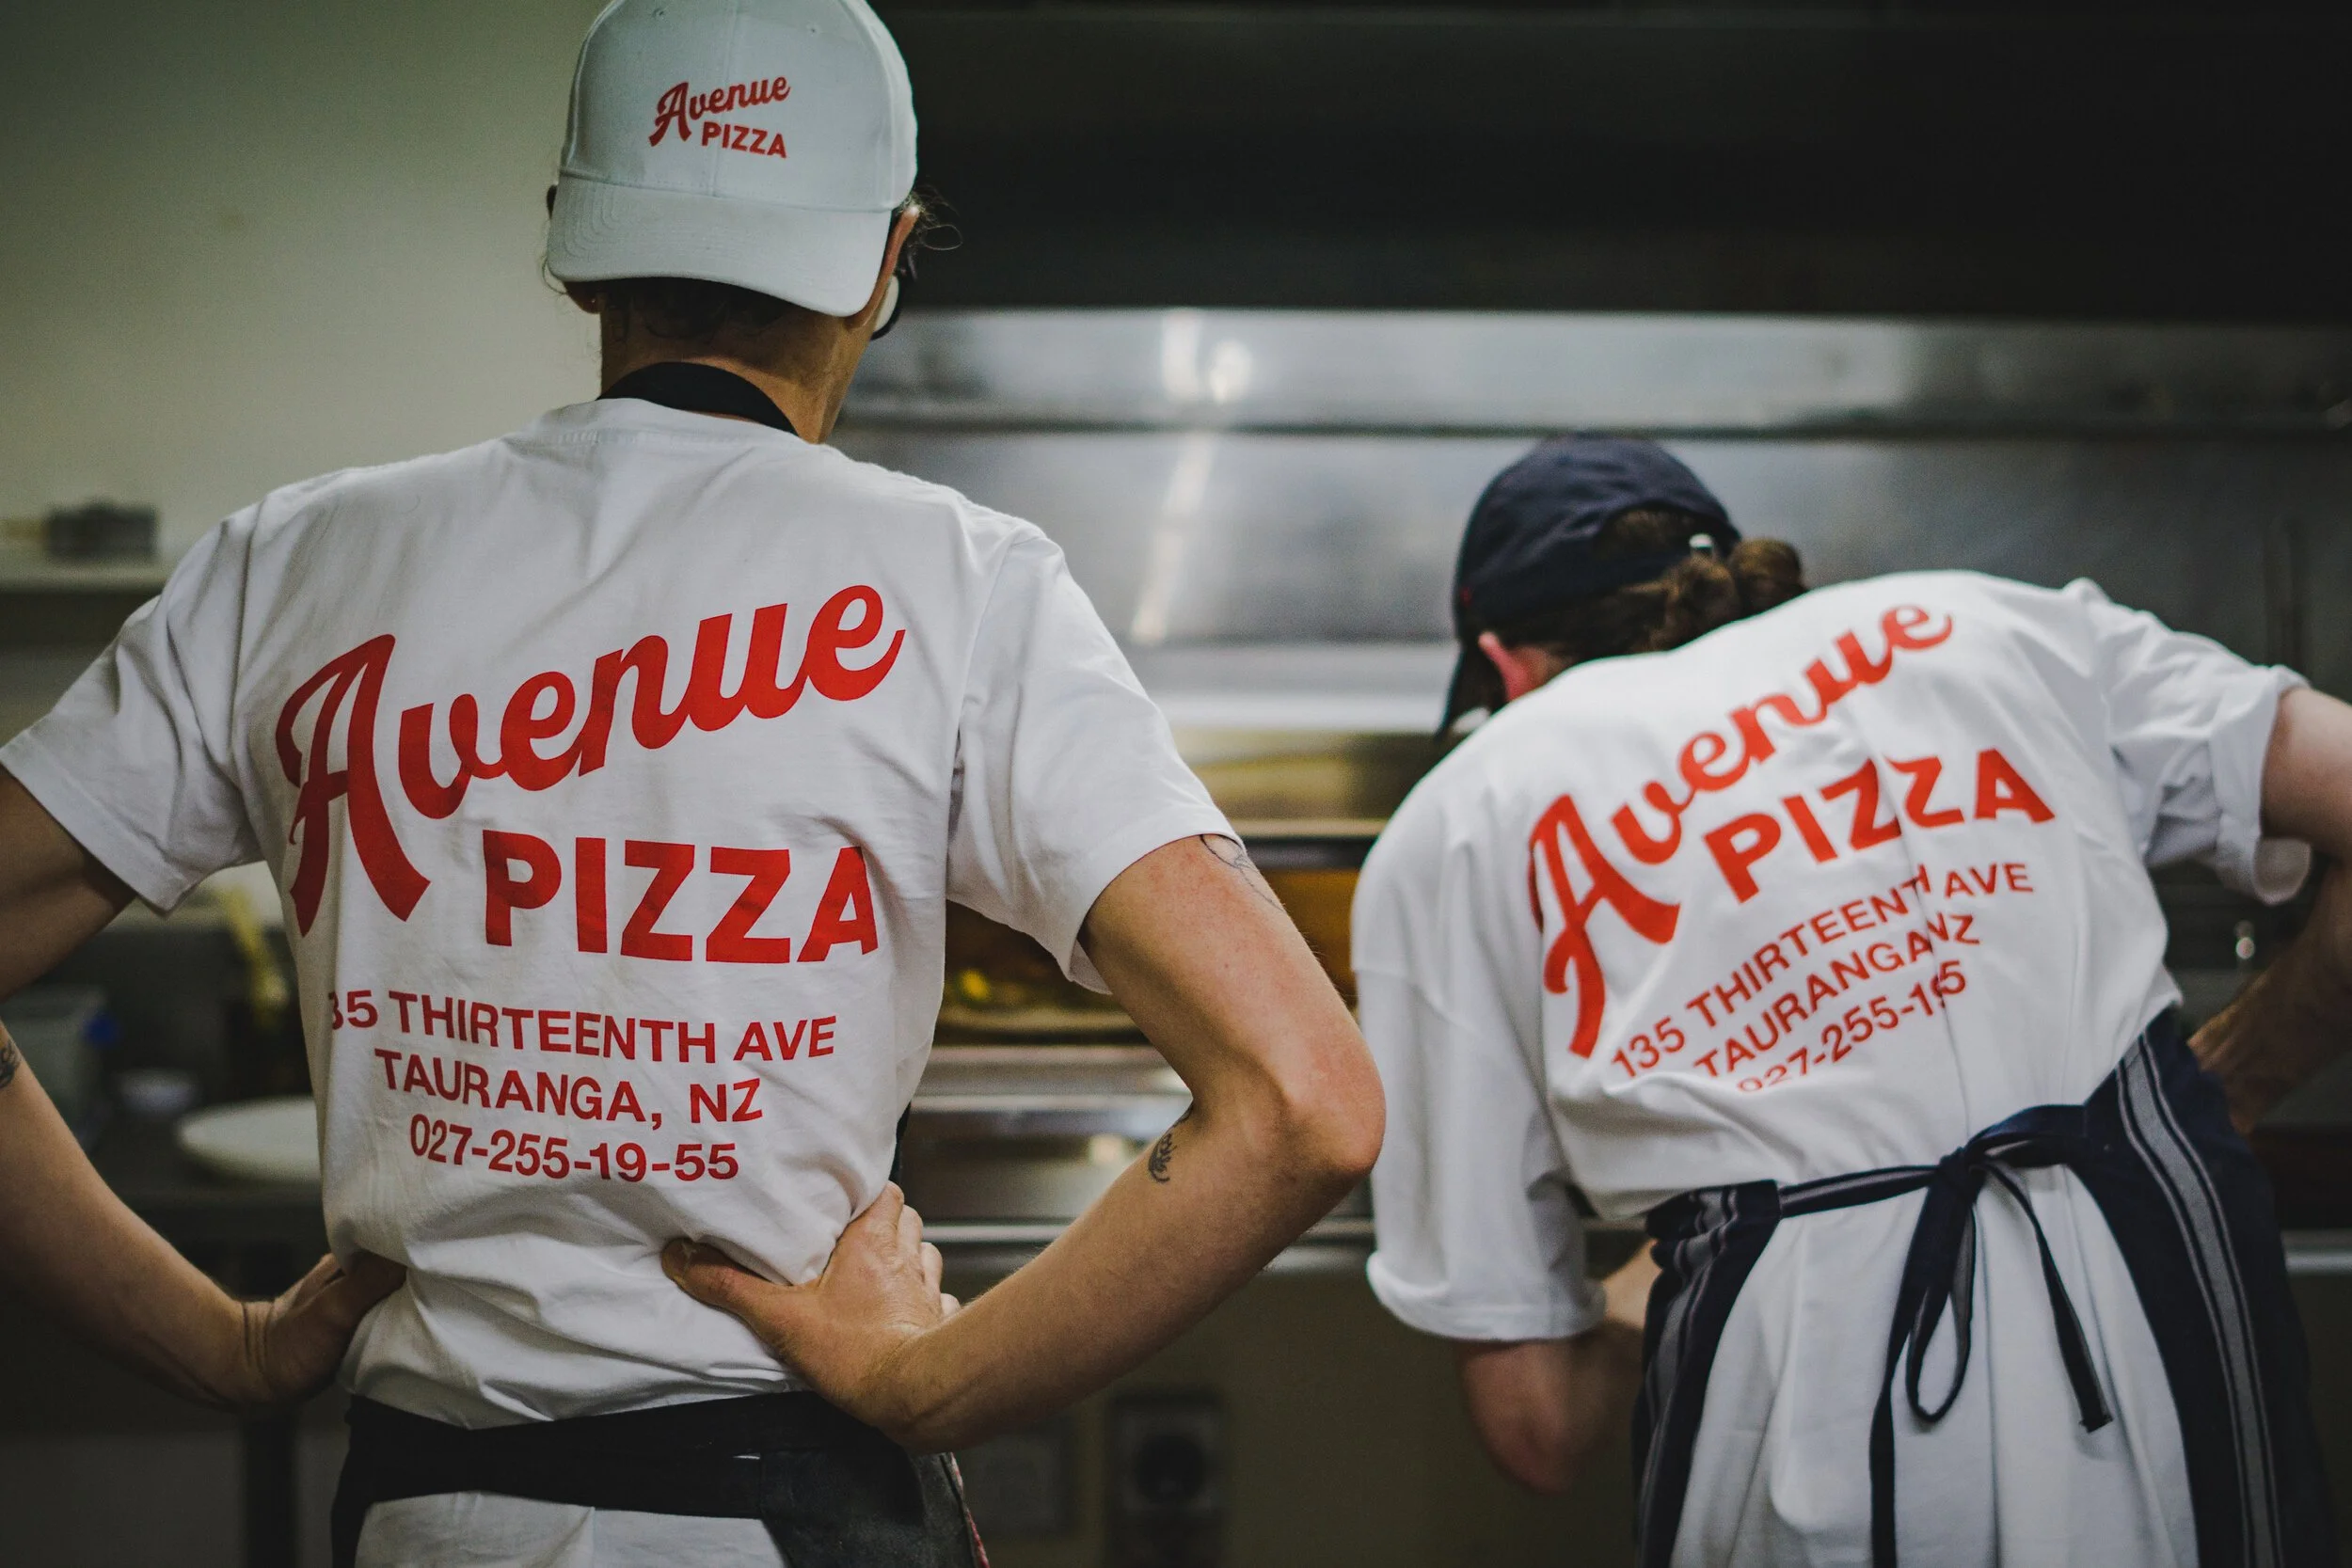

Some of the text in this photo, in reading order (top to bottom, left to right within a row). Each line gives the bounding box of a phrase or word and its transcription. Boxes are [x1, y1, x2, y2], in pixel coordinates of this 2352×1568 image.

[648, 76, 791, 147] Avenue
[701, 120, 788, 159] PIZZA
[274, 584, 906, 938] Avenue
[1528, 604, 1953, 1059] Avenue
[1704, 748, 2056, 904] PIZZA
[482, 830, 879, 964] PIZZA
[1611, 862, 2035, 1078] 135 THIRTEENTH AVE
[389, 990, 716, 1064] THIRTEENTH
[733, 1015, 837, 1062] AVE
[374, 1048, 764, 1131] TAURANGA, NZ
[408, 1113, 739, 1182] 027-255-19-55
